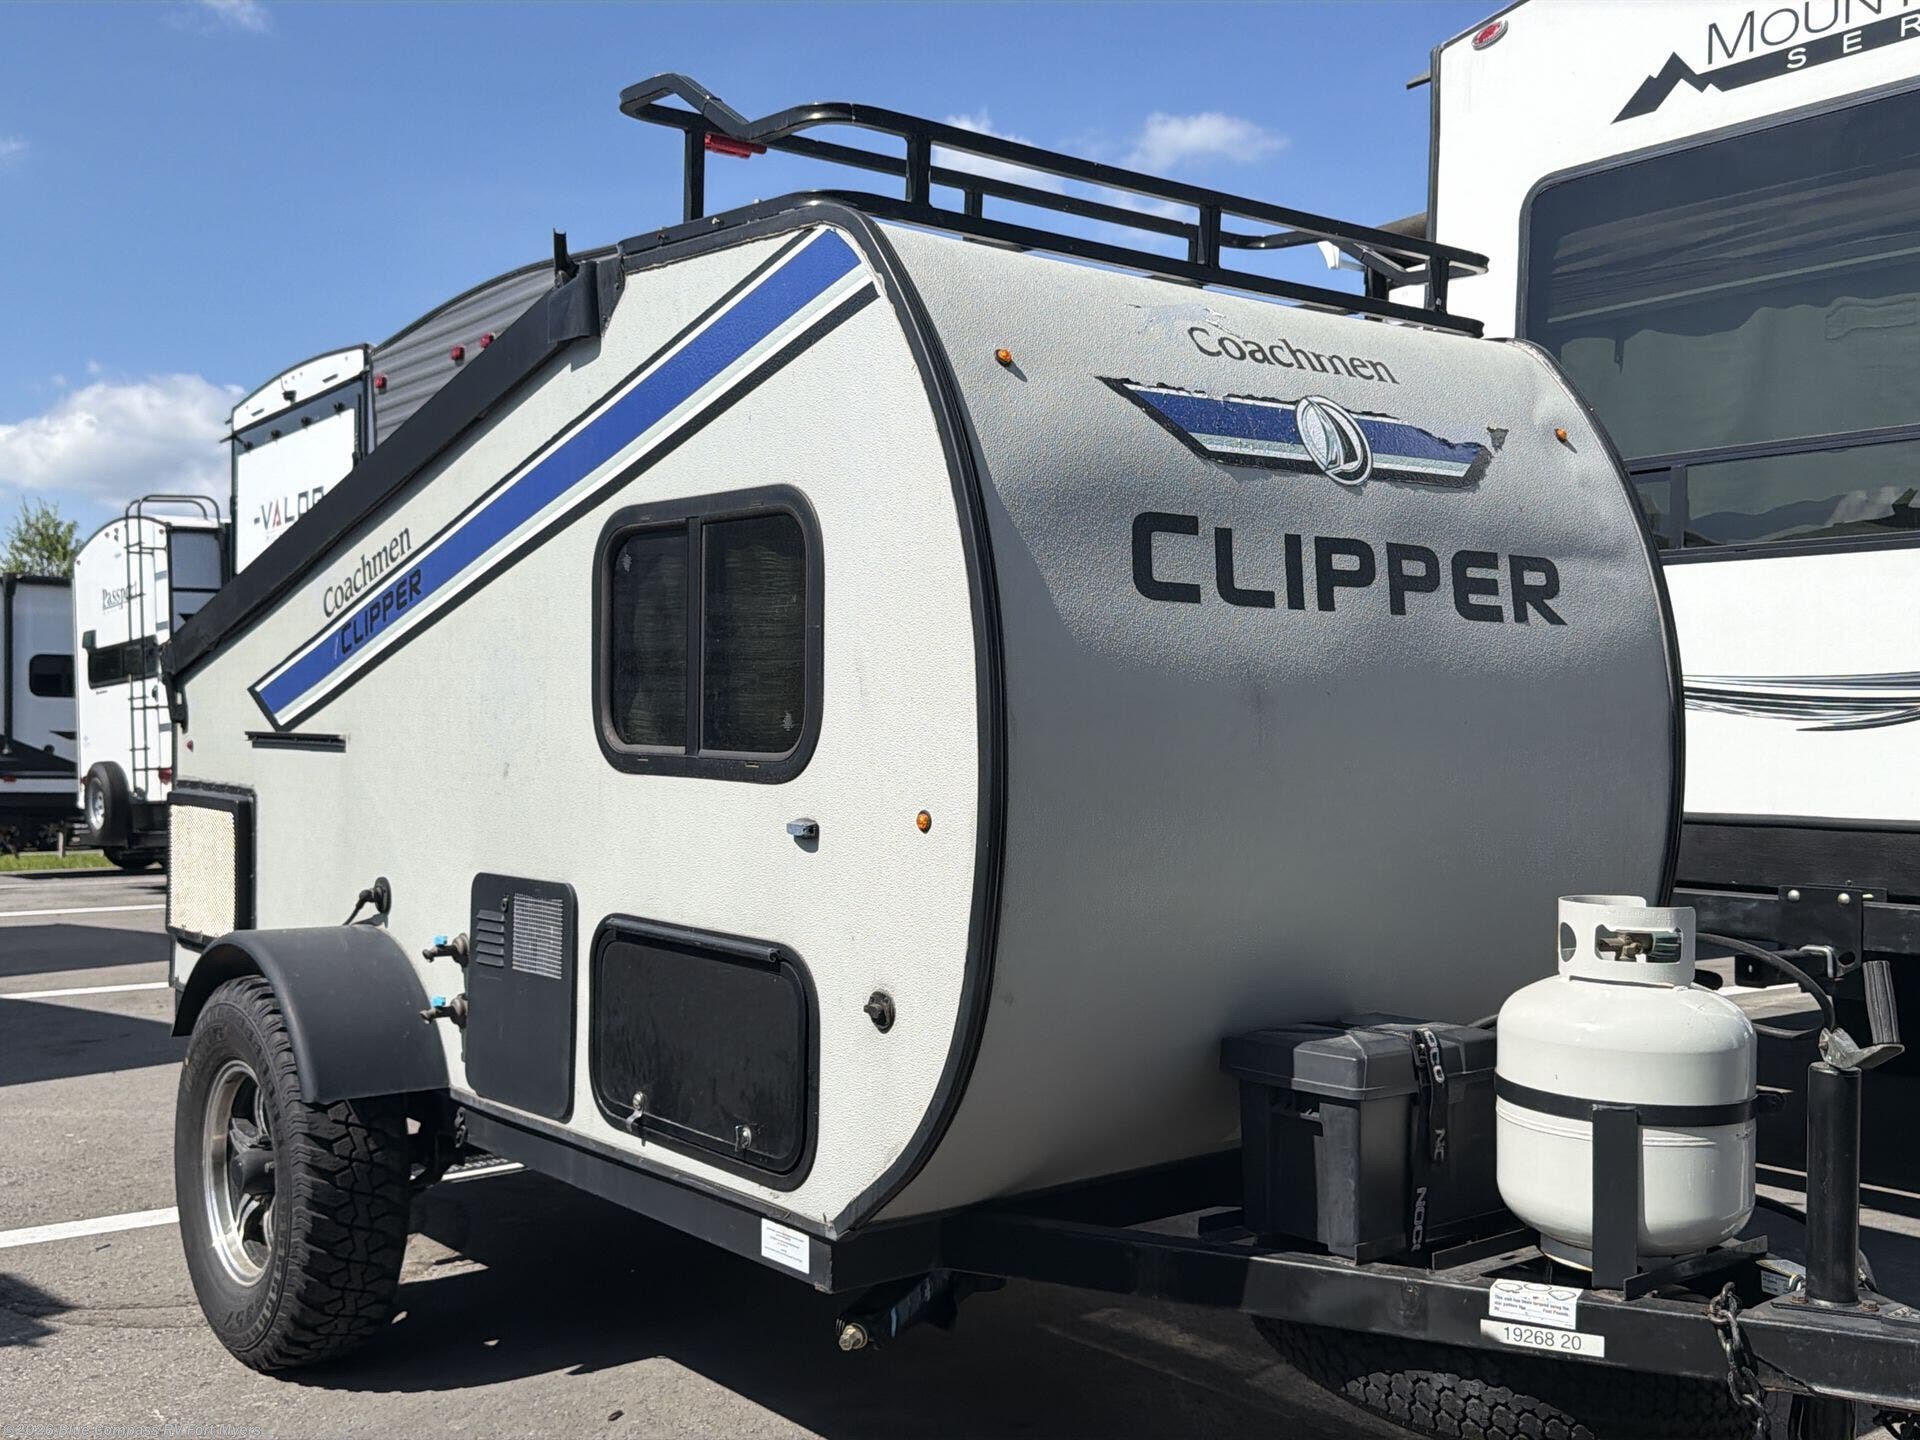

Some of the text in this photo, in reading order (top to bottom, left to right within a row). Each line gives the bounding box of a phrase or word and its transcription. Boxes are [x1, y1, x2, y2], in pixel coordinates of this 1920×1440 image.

[1707, 0, 1920, 65] MOUN
[1187, 325, 1400, 385] Coachmen
[323, 527, 412, 618] Coachmen
[1131, 511, 1568, 627] CLIPPER
[341, 568, 422, 655] CLIPPER
[1503, 1326, 1582, 1351] 19268 20
